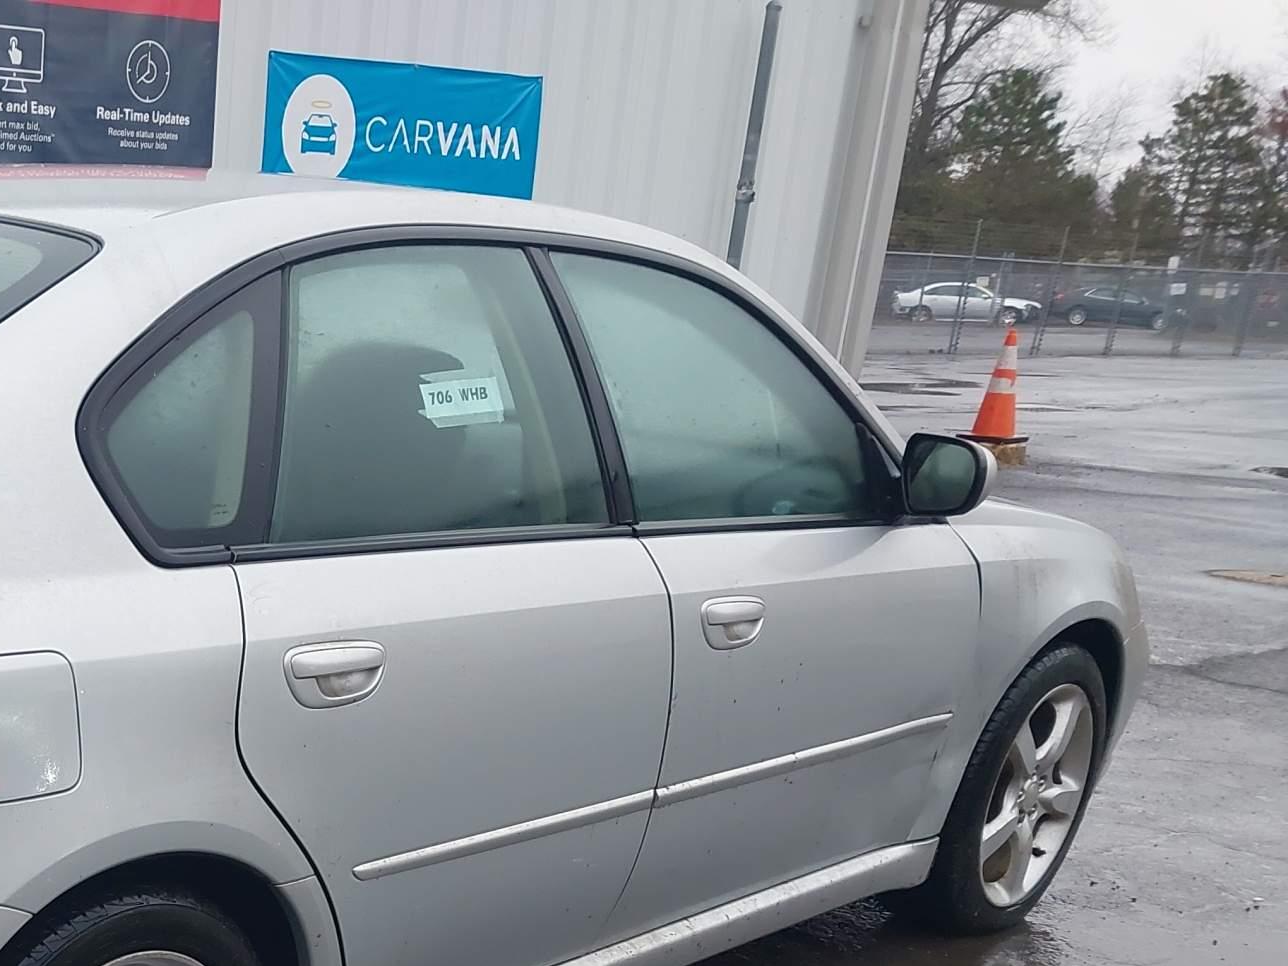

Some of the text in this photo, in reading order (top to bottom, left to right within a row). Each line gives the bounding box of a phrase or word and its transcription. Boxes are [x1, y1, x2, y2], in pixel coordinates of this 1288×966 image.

[6, 100, 27, 114] and
[31, 100, 56, 119] Easy
[96, 106, 190, 126] Real-Time Updates
[8, 121, 25, 130] max
[26, 121, 40, 132] bid,
[108, 127, 179, 141] Receive status updates
[119, 138, 168, 150] about your bids
[365, 116, 520, 160] CARVANA
[6, 141, 16, 152] for
[18, 143, 32, 153] you
[428, 386, 488, 406] 706 WHB
